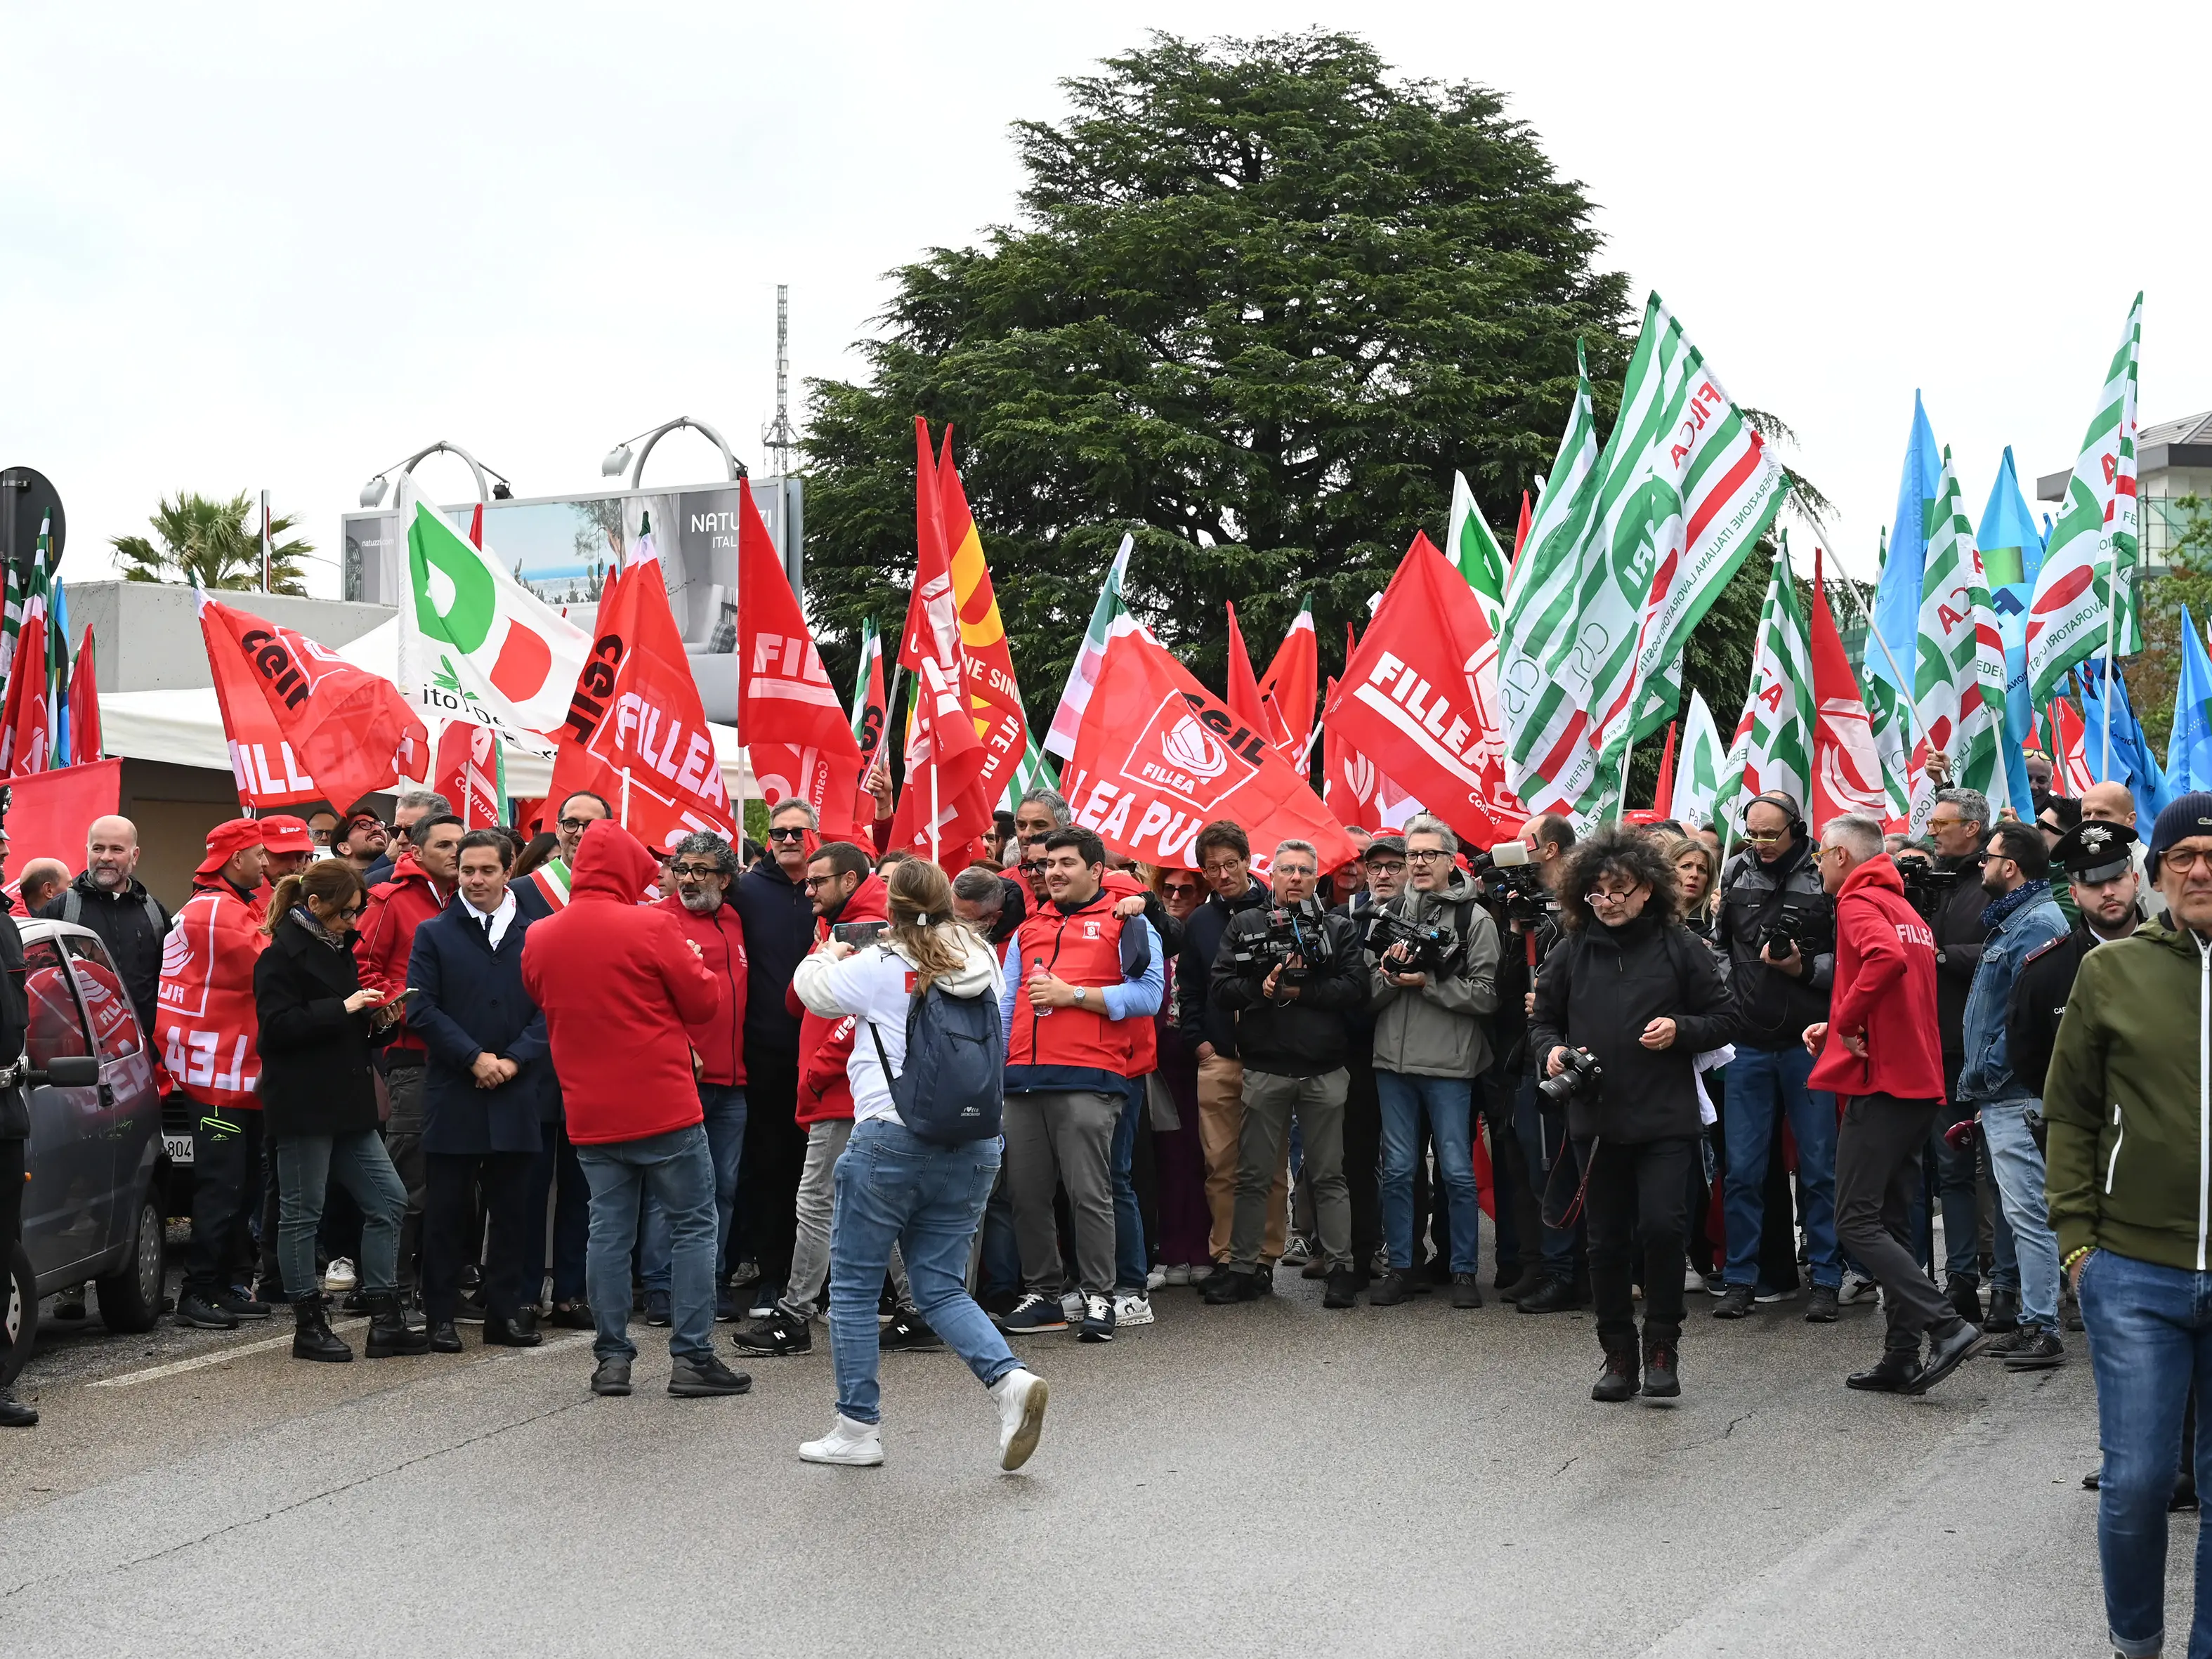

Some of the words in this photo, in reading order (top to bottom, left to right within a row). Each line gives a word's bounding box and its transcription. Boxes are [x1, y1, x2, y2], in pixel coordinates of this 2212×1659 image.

[712, 535, 738, 548] ITAL
[752, 632, 829, 684] FIL
[1368, 650, 1490, 774] FILLEA
[615, 691, 725, 808] FILLEA
[1142, 762, 1195, 794] FILLEA
[1895, 924, 1935, 951] FILLEA
